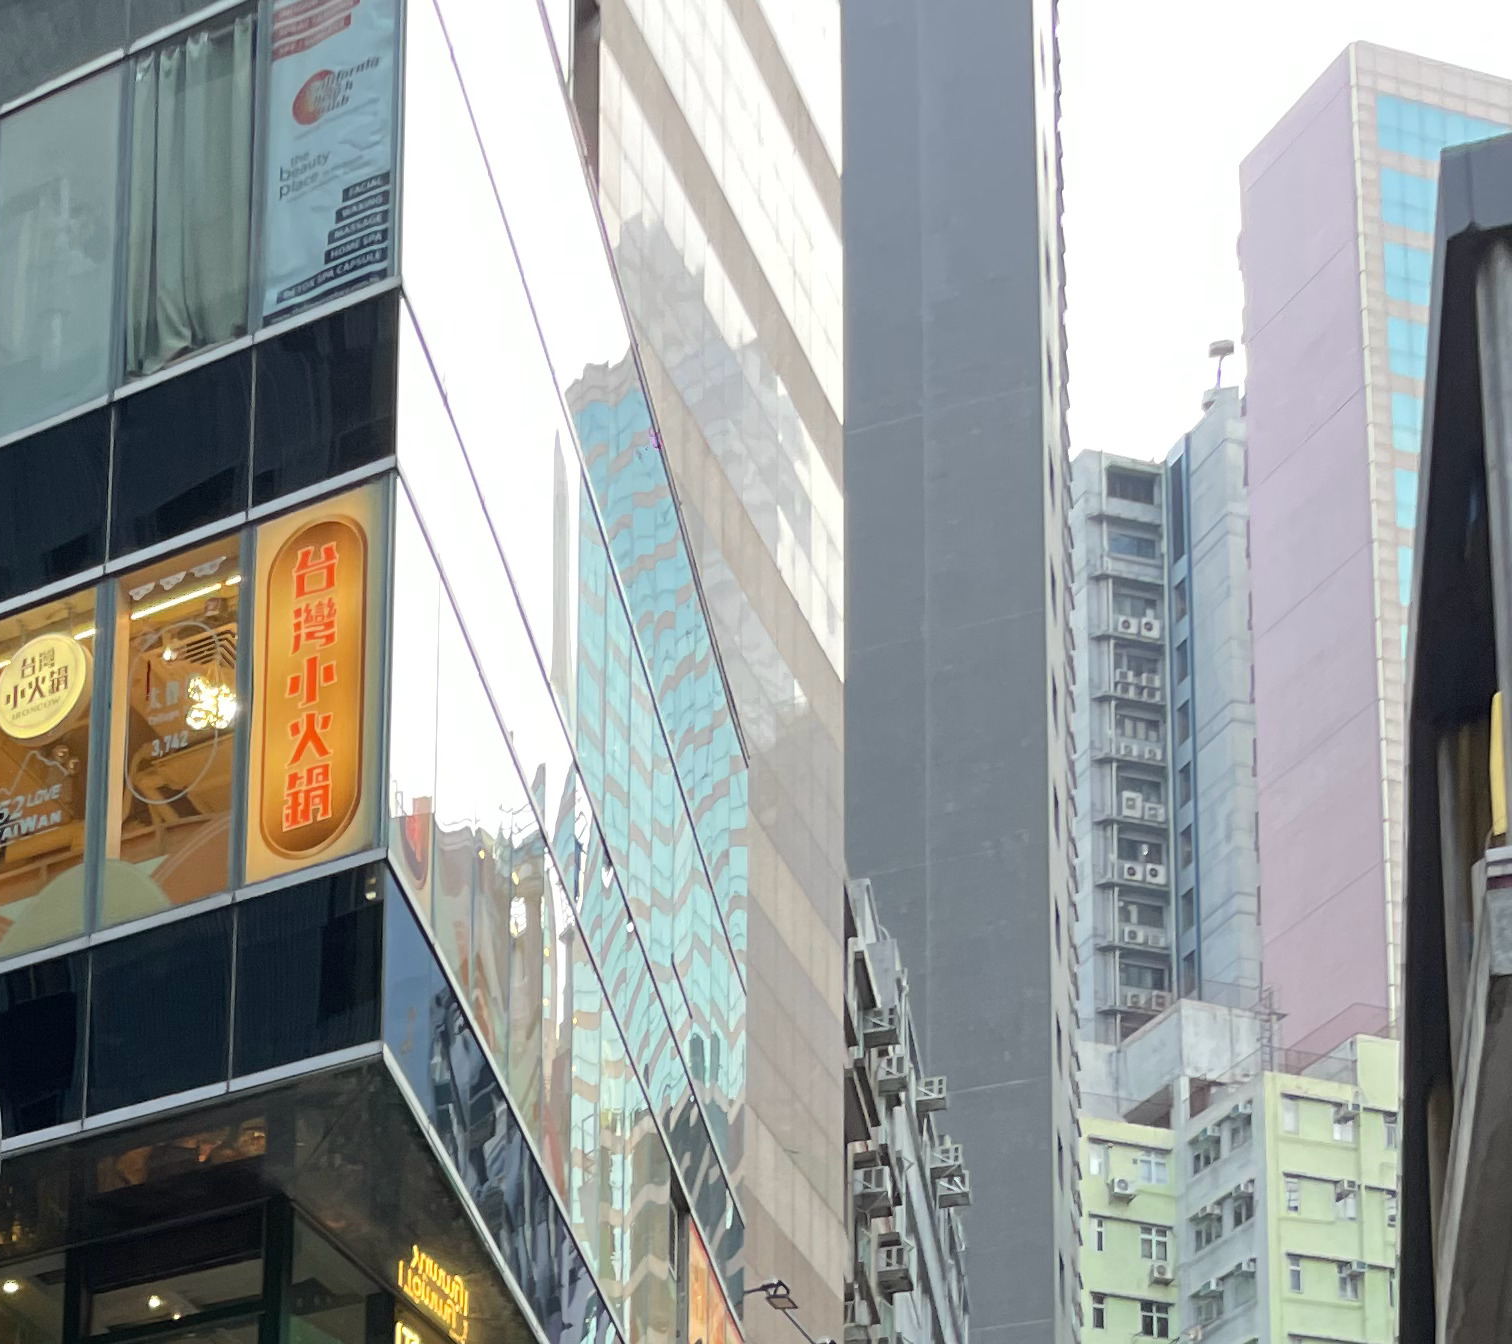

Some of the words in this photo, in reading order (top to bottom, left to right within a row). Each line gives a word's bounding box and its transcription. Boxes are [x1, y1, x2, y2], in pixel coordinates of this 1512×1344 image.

[20, 646, 56, 680] 台灣
[5, 666, 69, 710] 小火鍋
[281, 541, 340, 832] 台灣小火鍋
[26, 784, 63, 808] LOVE
